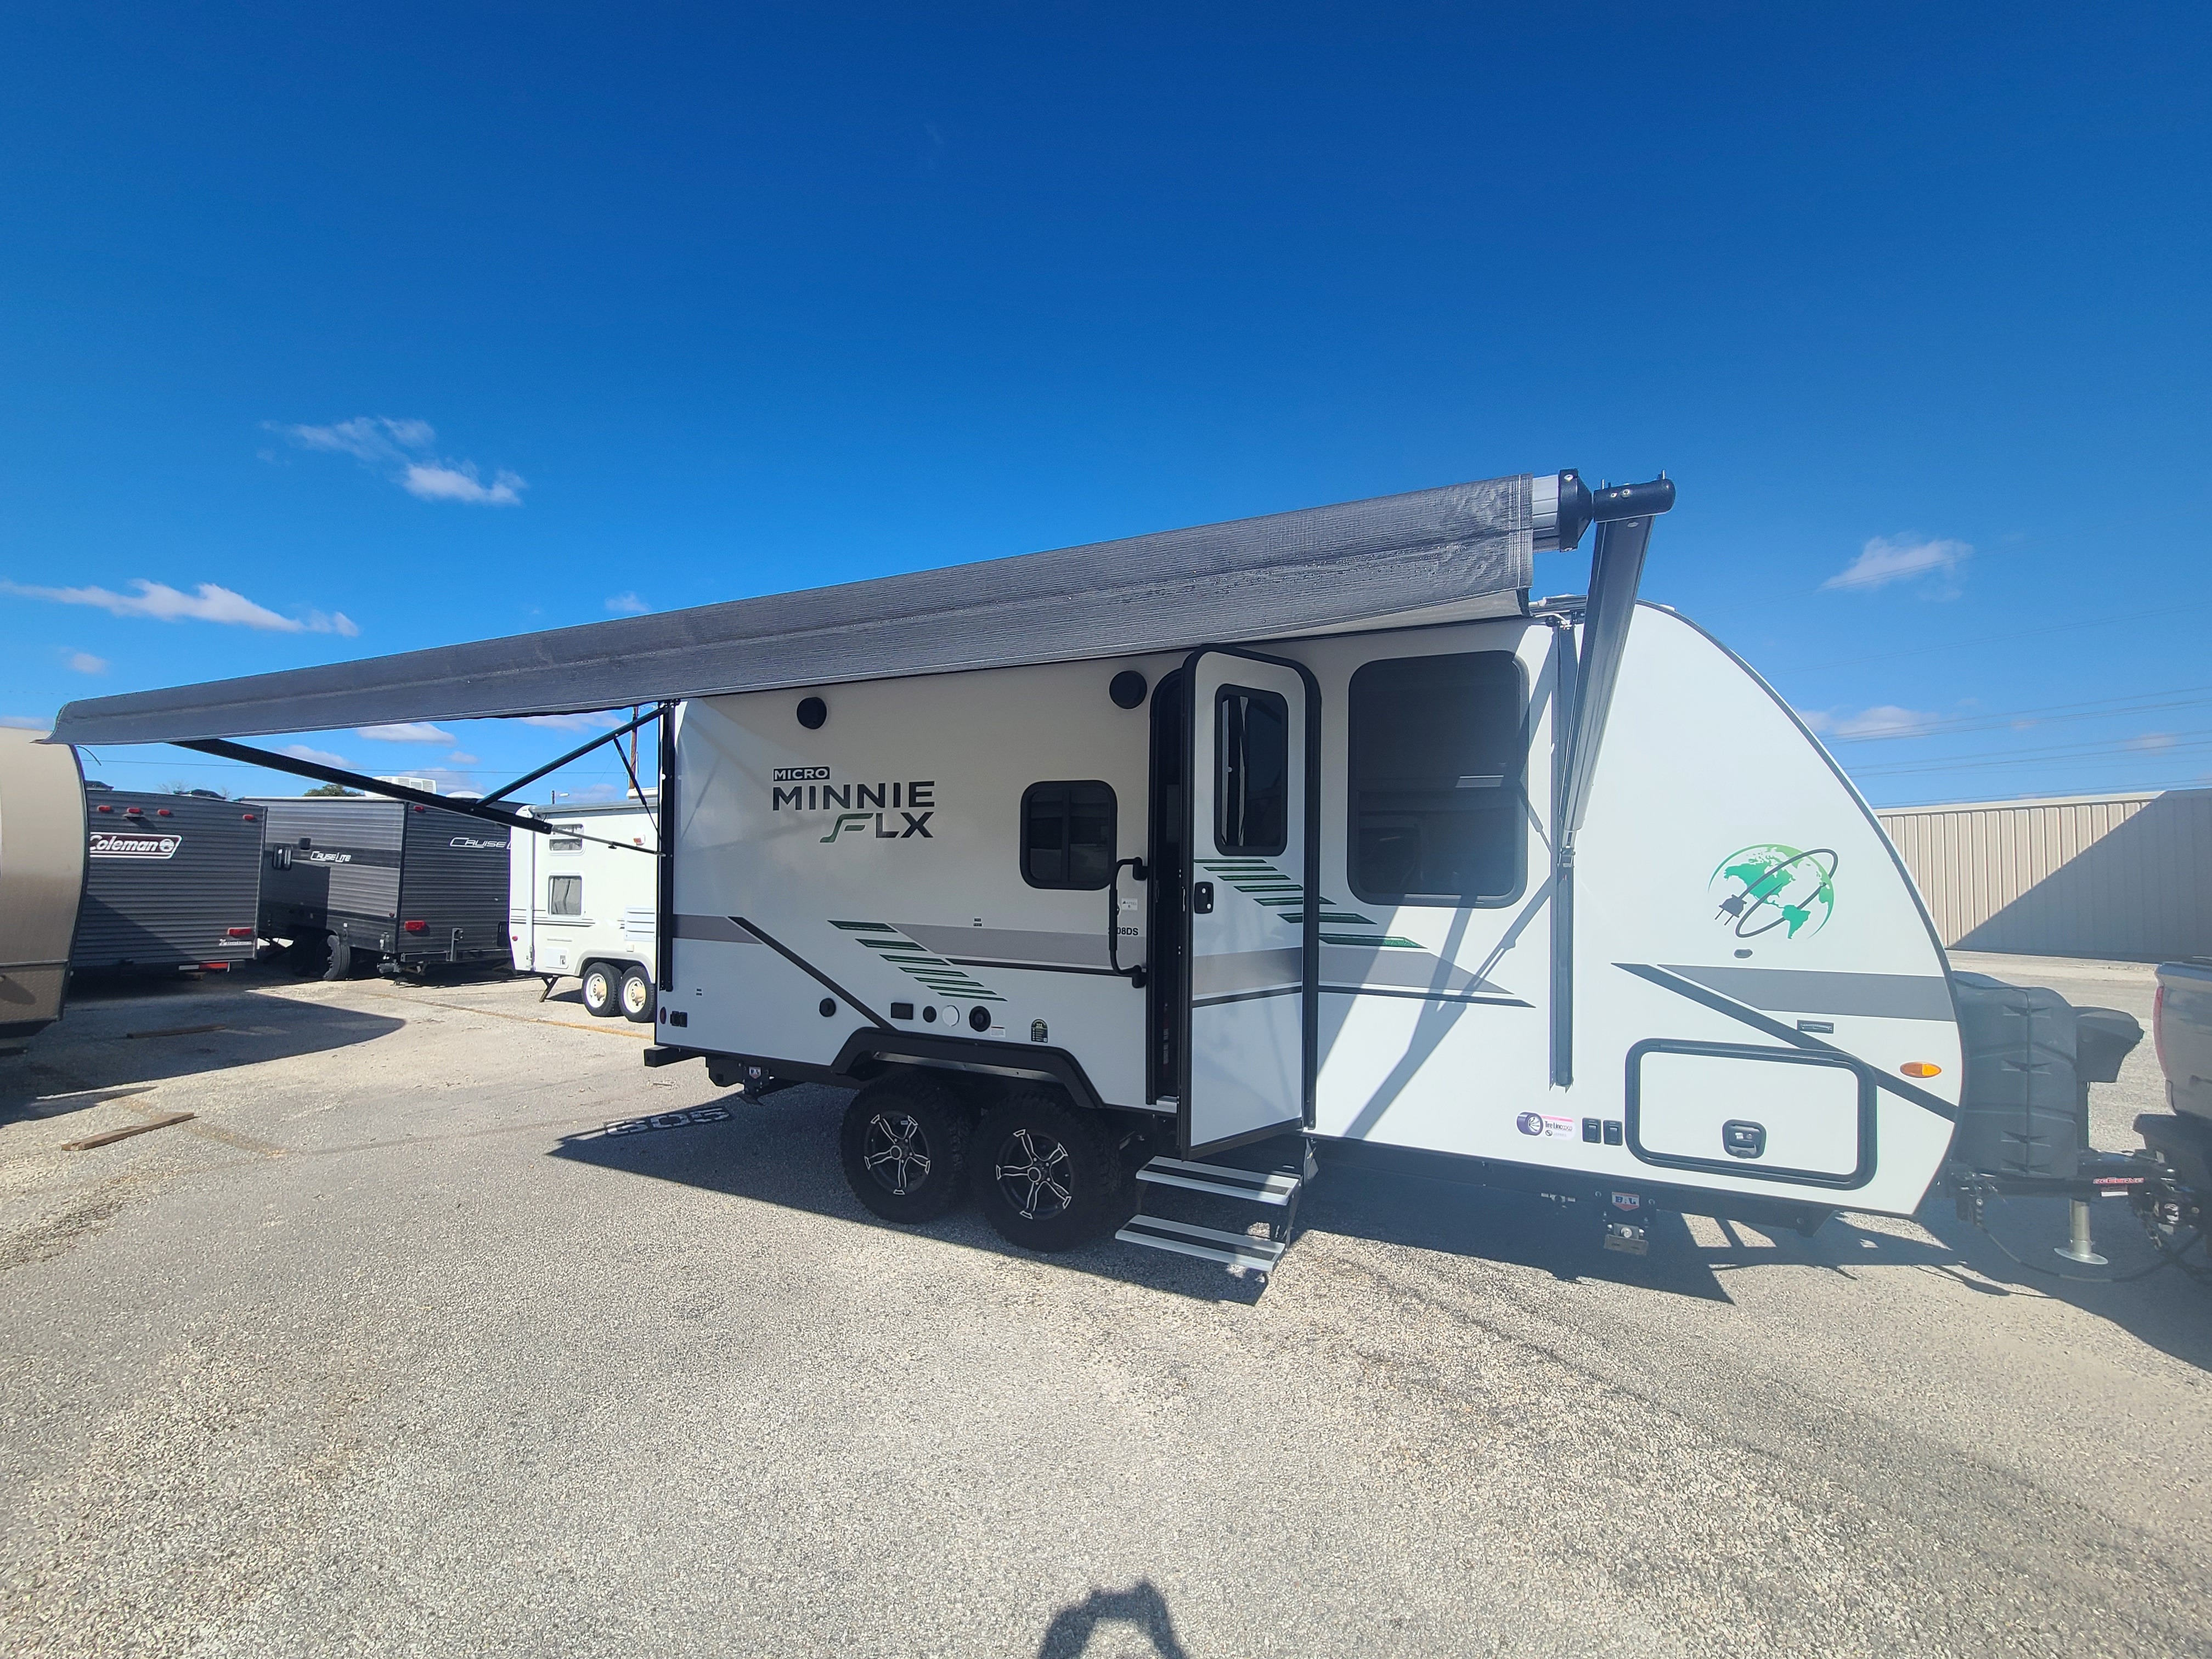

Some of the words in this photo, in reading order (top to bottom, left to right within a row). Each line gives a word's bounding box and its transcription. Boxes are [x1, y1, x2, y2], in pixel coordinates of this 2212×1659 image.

[774, 768, 828, 780] MICRO
[772, 781, 935, 811] MINNIE
[820, 811, 934, 843] FLX
[90, 835, 159, 851] Coleman
[1108, 927, 1138, 935] 08DS
